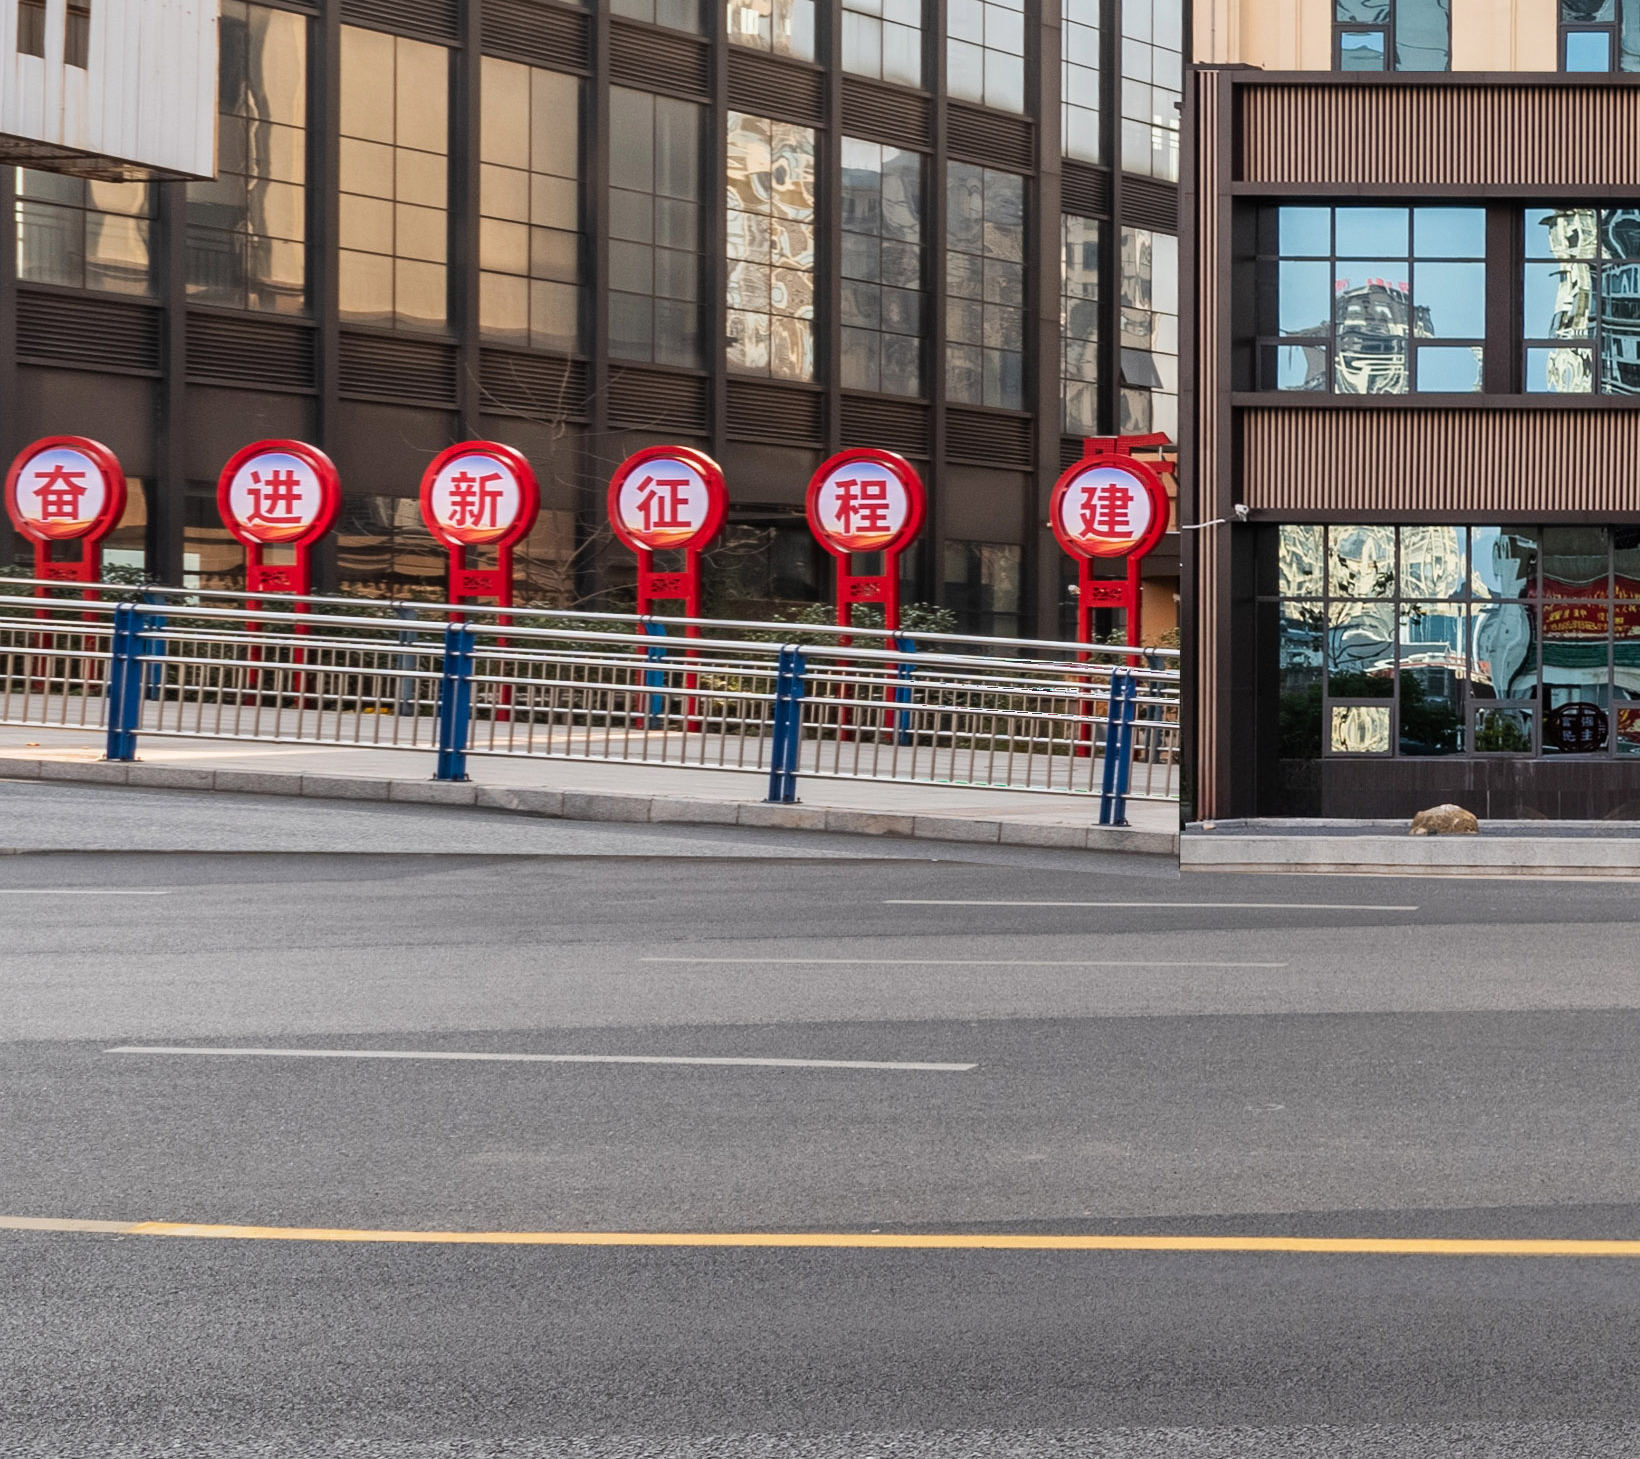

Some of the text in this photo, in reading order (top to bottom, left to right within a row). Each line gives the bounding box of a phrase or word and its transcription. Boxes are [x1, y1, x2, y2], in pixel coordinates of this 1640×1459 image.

[33, 465, 87, 521] 奋
[247, 469, 303, 525] 进
[448, 471, 504, 528] 新
[636, 475, 692, 533] 征
[834, 479, 891, 535] 程
[1079, 483, 1134, 539] 建
